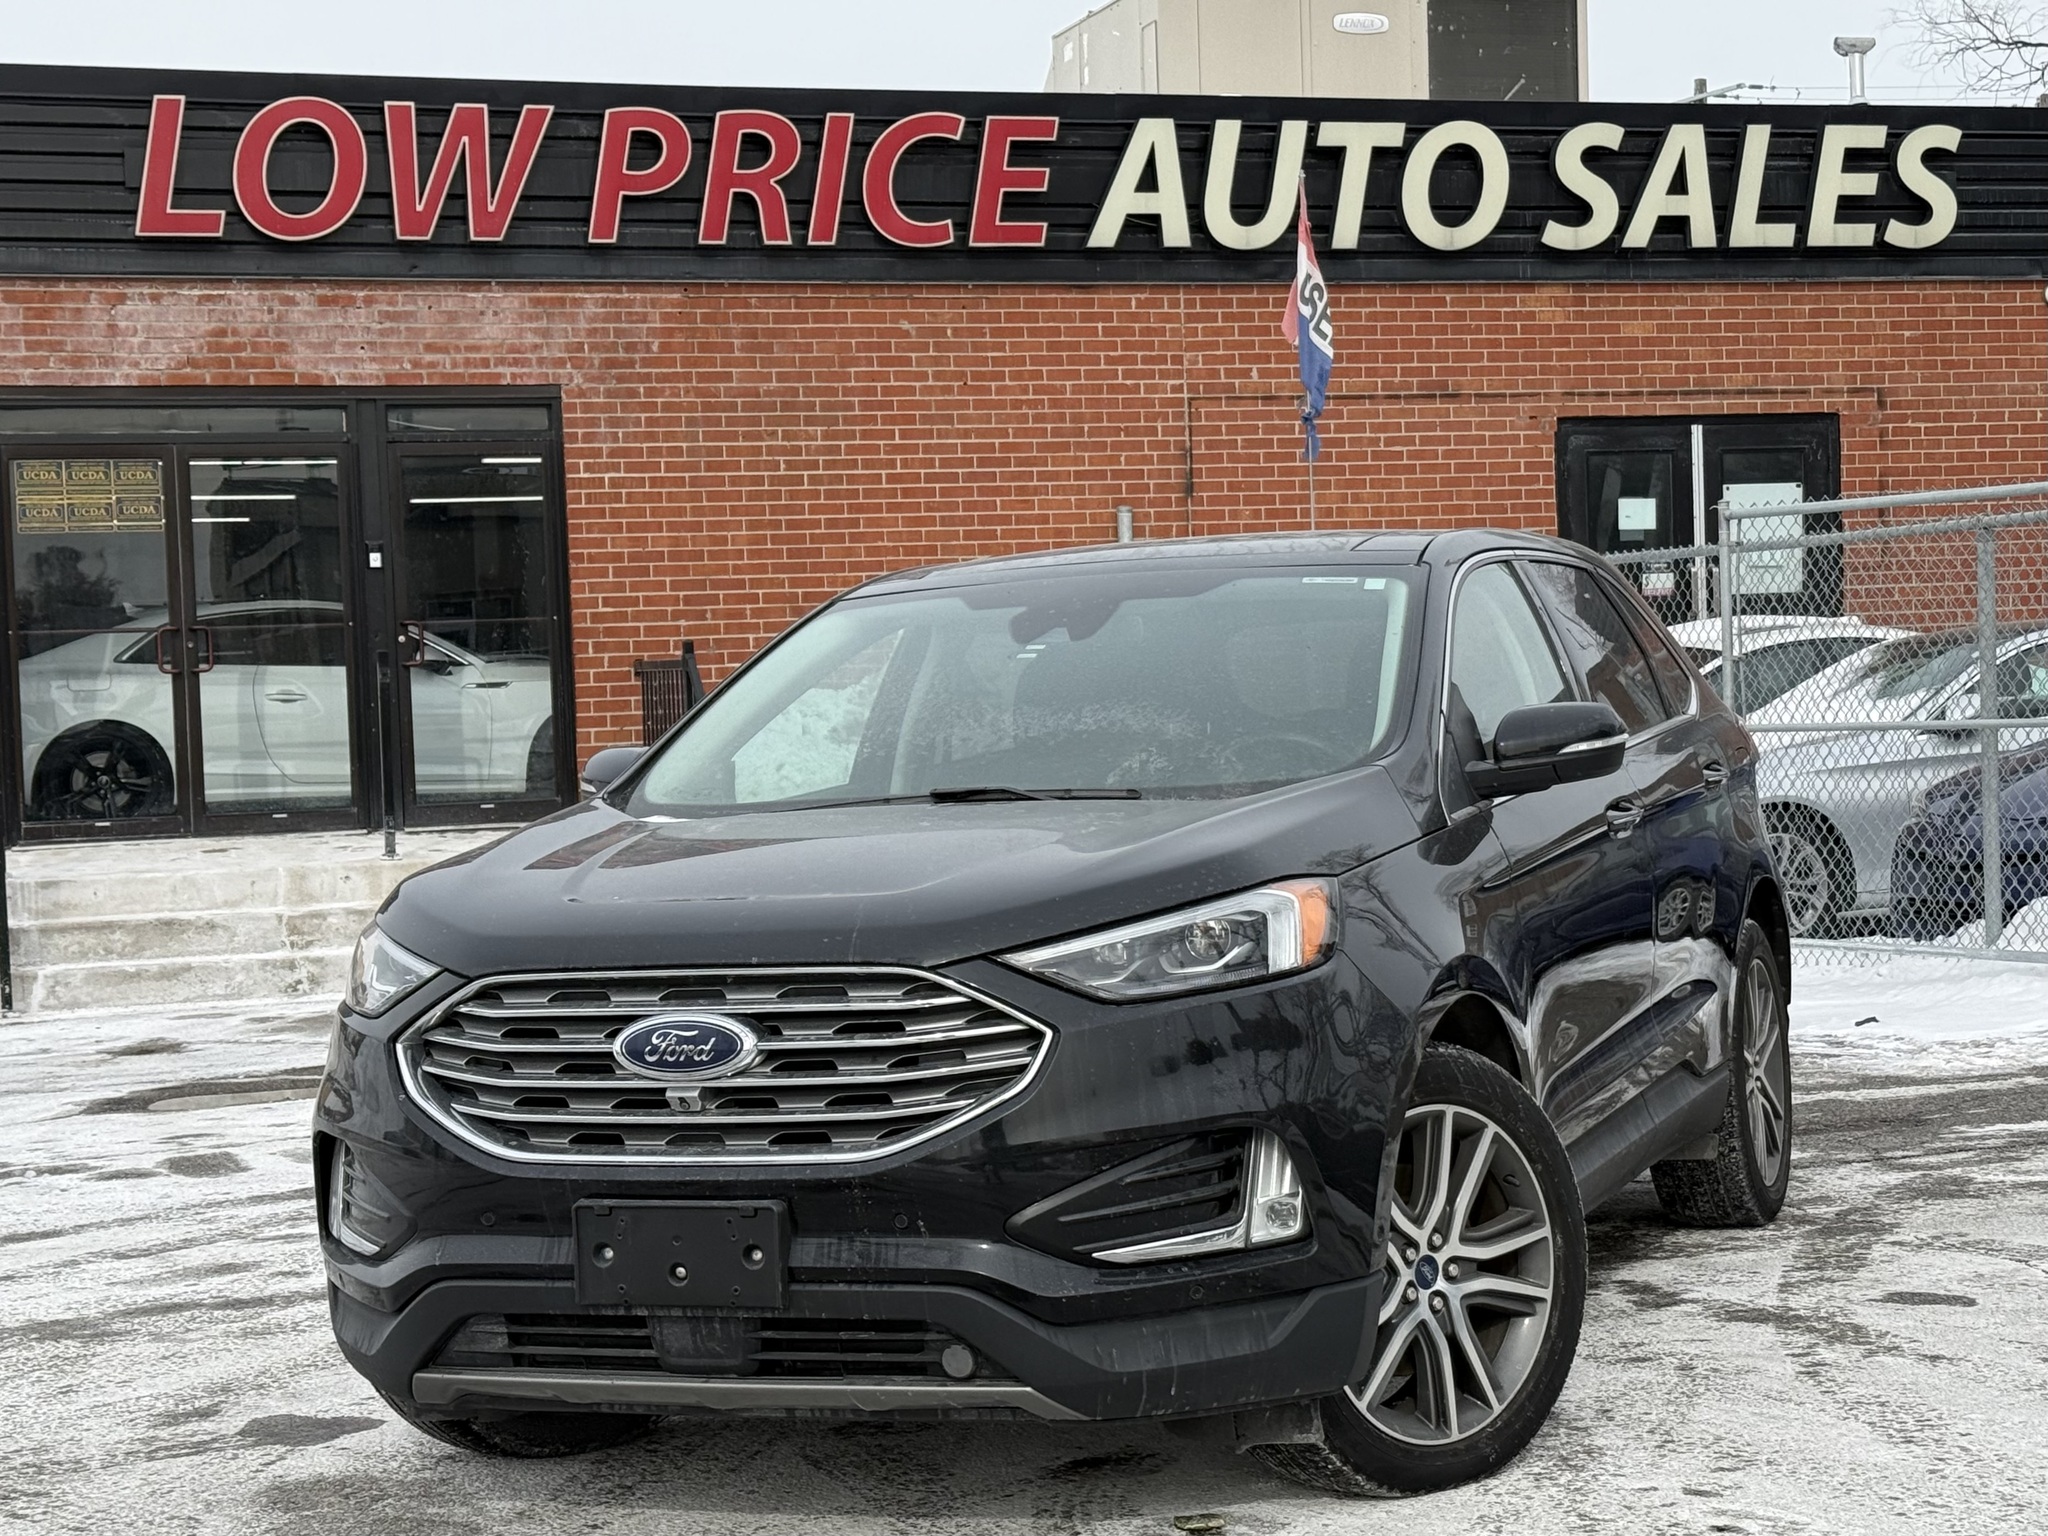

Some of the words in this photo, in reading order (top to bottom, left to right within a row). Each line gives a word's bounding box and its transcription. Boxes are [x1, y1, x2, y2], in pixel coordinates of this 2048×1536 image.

[1339, 18, 1375, 28] LENNOX
[135, 95, 554, 241] LOW
[588, 106, 1059, 247] PRICE
[1085, 118, 1510, 251] AUTO
[1540, 122, 1963, 250] SALES
[23, 471, 57, 480] UCDA
[72, 471, 105, 480] UCDA
[120, 471, 153, 480] UCDA
[25, 509, 59, 517] UCDA
[74, 508, 106, 516] UCDA
[122, 505, 156, 514] UCDA
[644, 1029, 716, 1062] Ford
